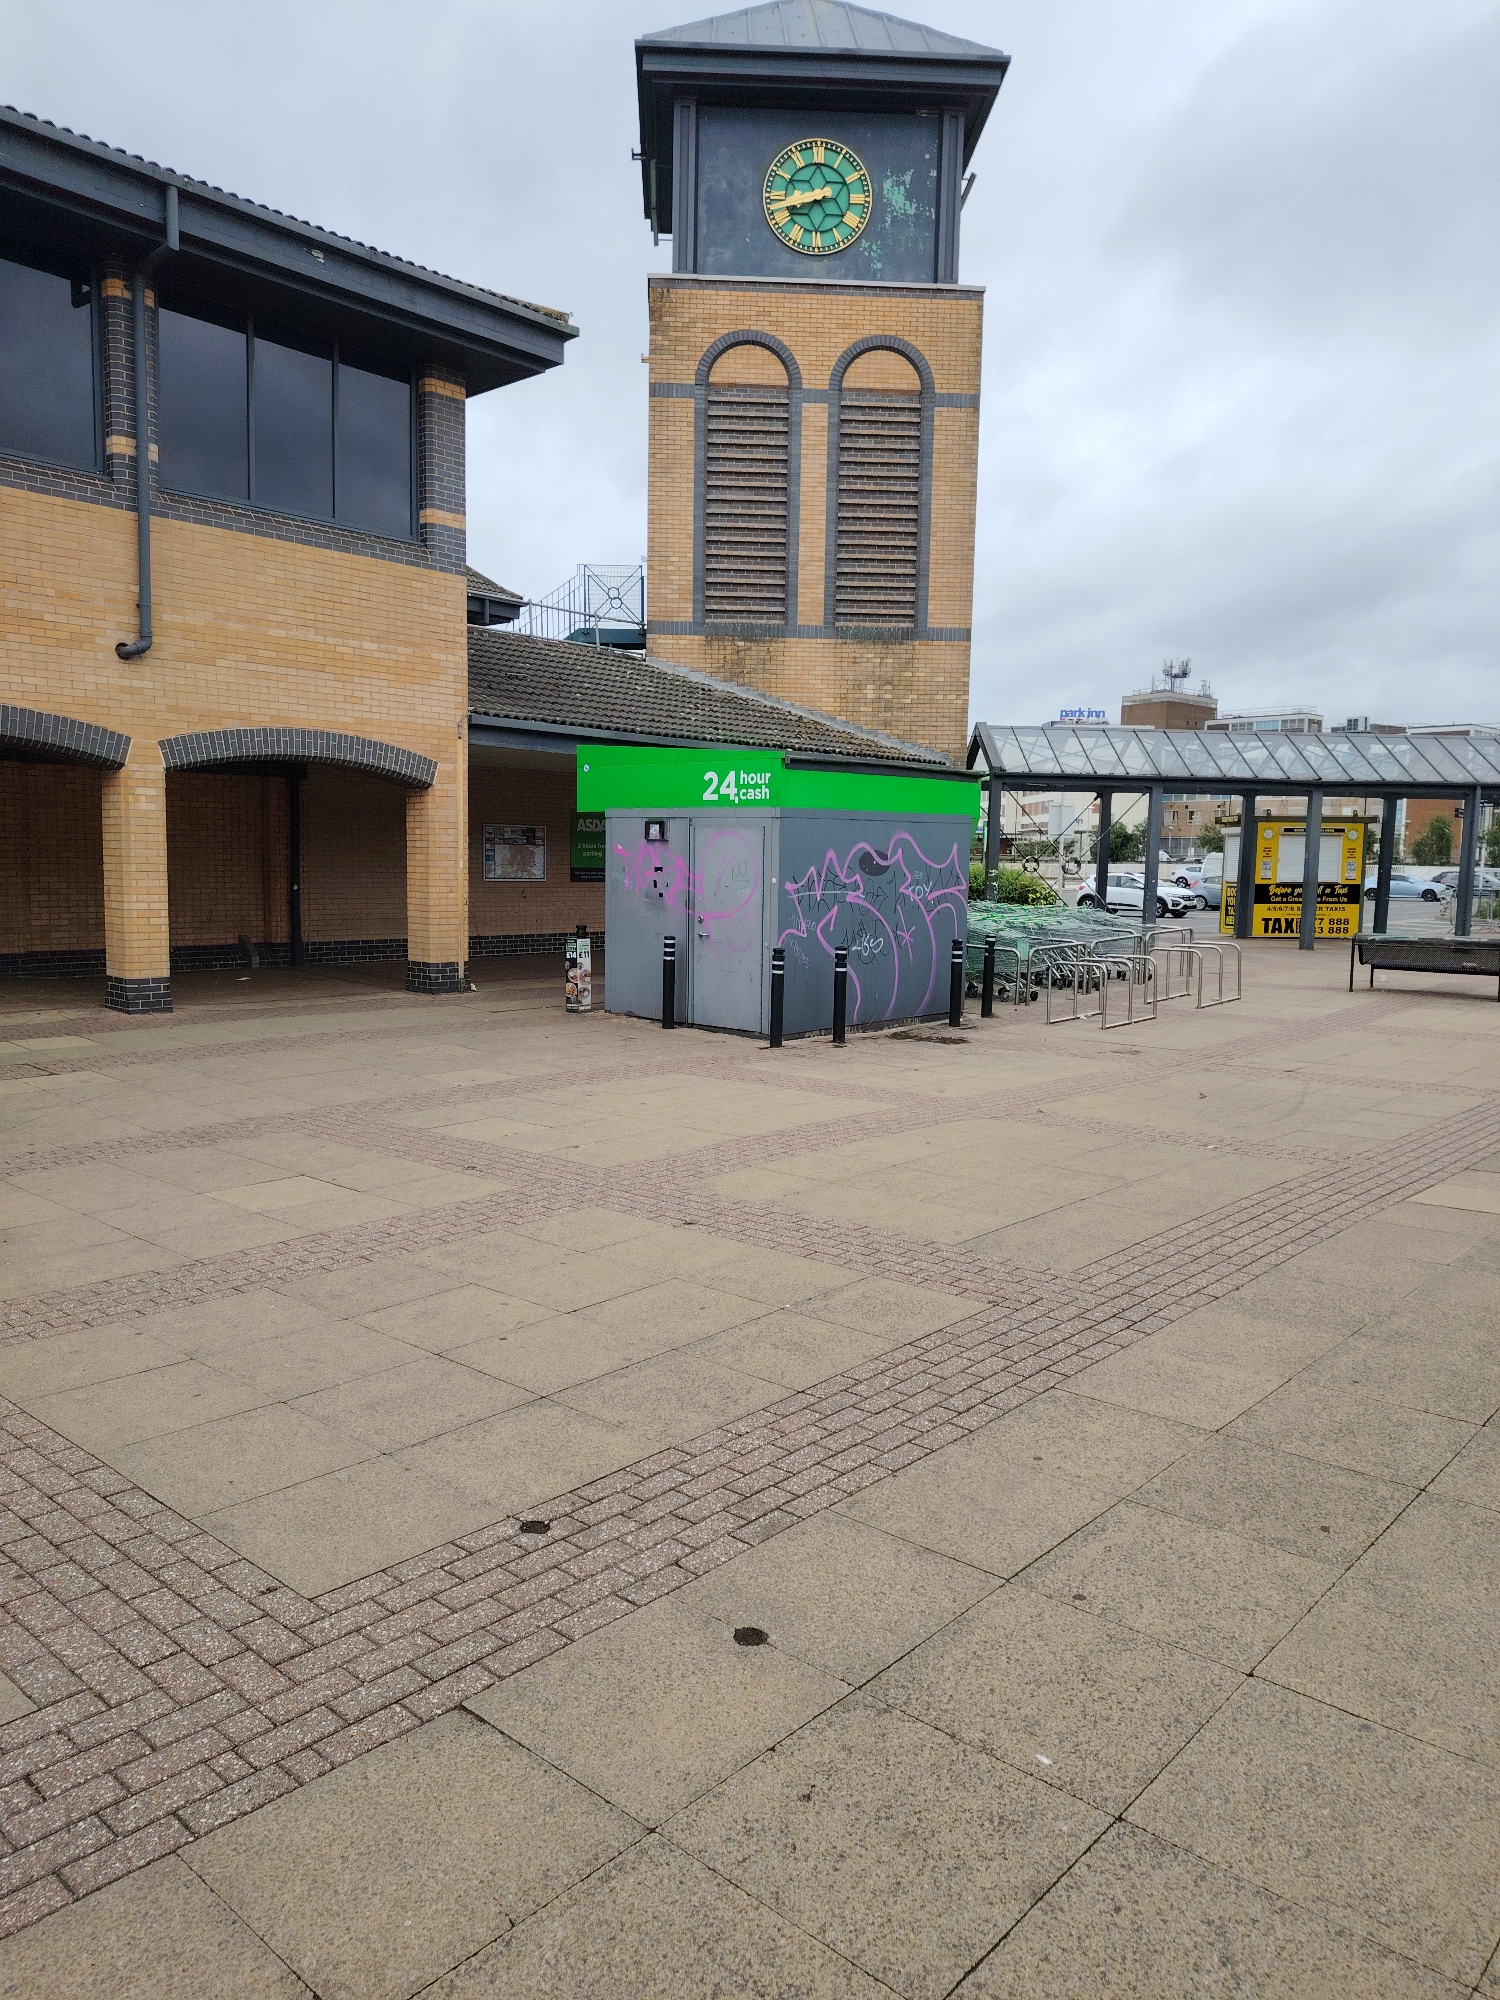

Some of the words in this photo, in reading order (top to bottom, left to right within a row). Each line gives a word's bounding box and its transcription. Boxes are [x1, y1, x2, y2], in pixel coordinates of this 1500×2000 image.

[1060, 708, 1085, 721] park
[1088, 708, 1106, 718] inn
[740, 770, 771, 784] hour
[740, 785, 770, 800] cash
[1269, 885, 1292, 896] Before
[1334, 885, 1349, 895] Taxi
[1329, 918, 1350, 926] 888
[579, 951, 590, 959] £11
